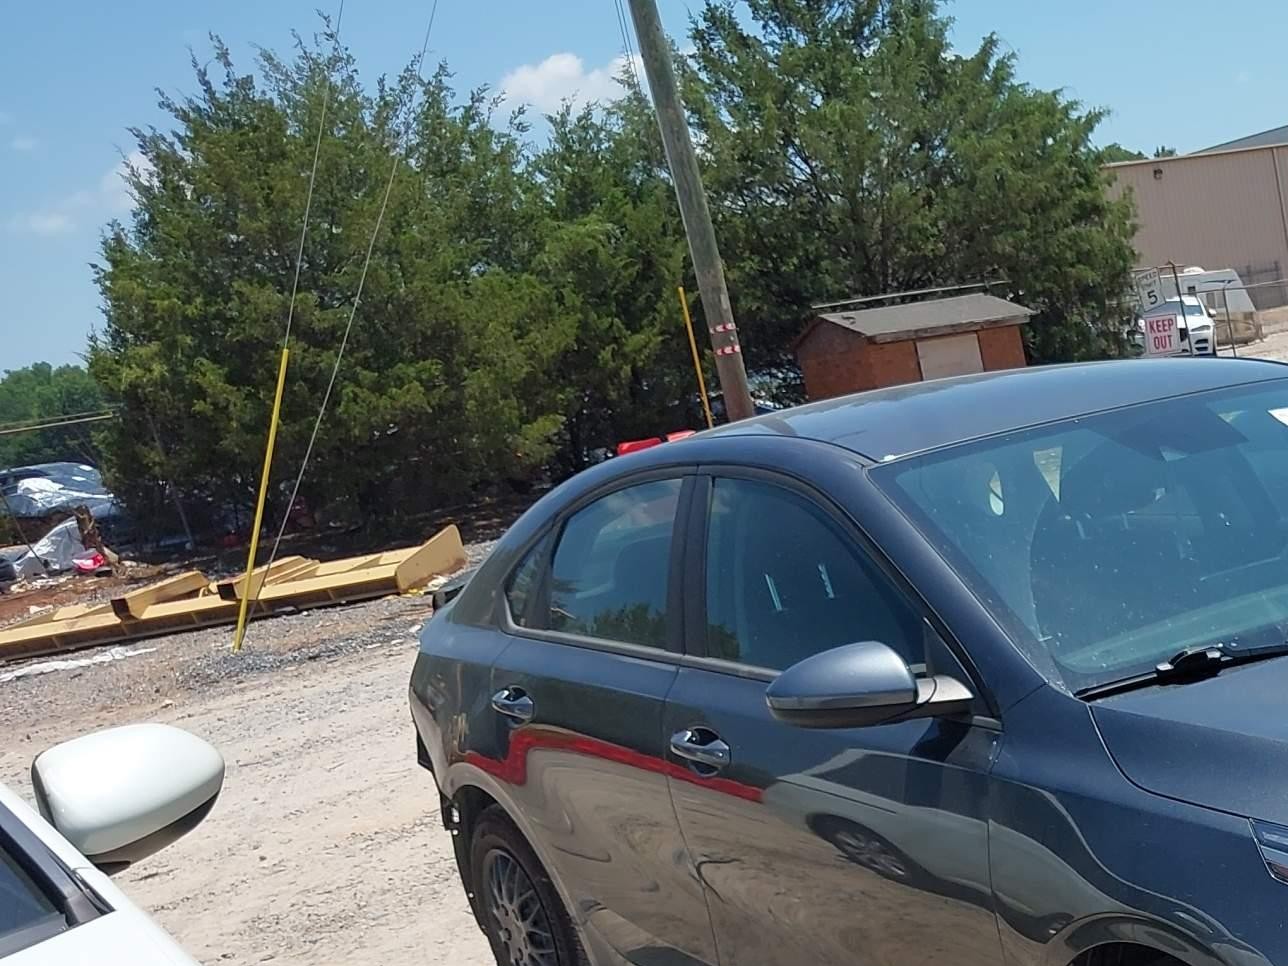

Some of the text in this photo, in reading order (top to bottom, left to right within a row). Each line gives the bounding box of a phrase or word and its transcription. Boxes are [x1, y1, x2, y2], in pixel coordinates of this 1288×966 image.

[1147, 290, 1158, 305] 5
[1149, 318, 1174, 334] KEEP
[1153, 335, 1173, 350] OUT
